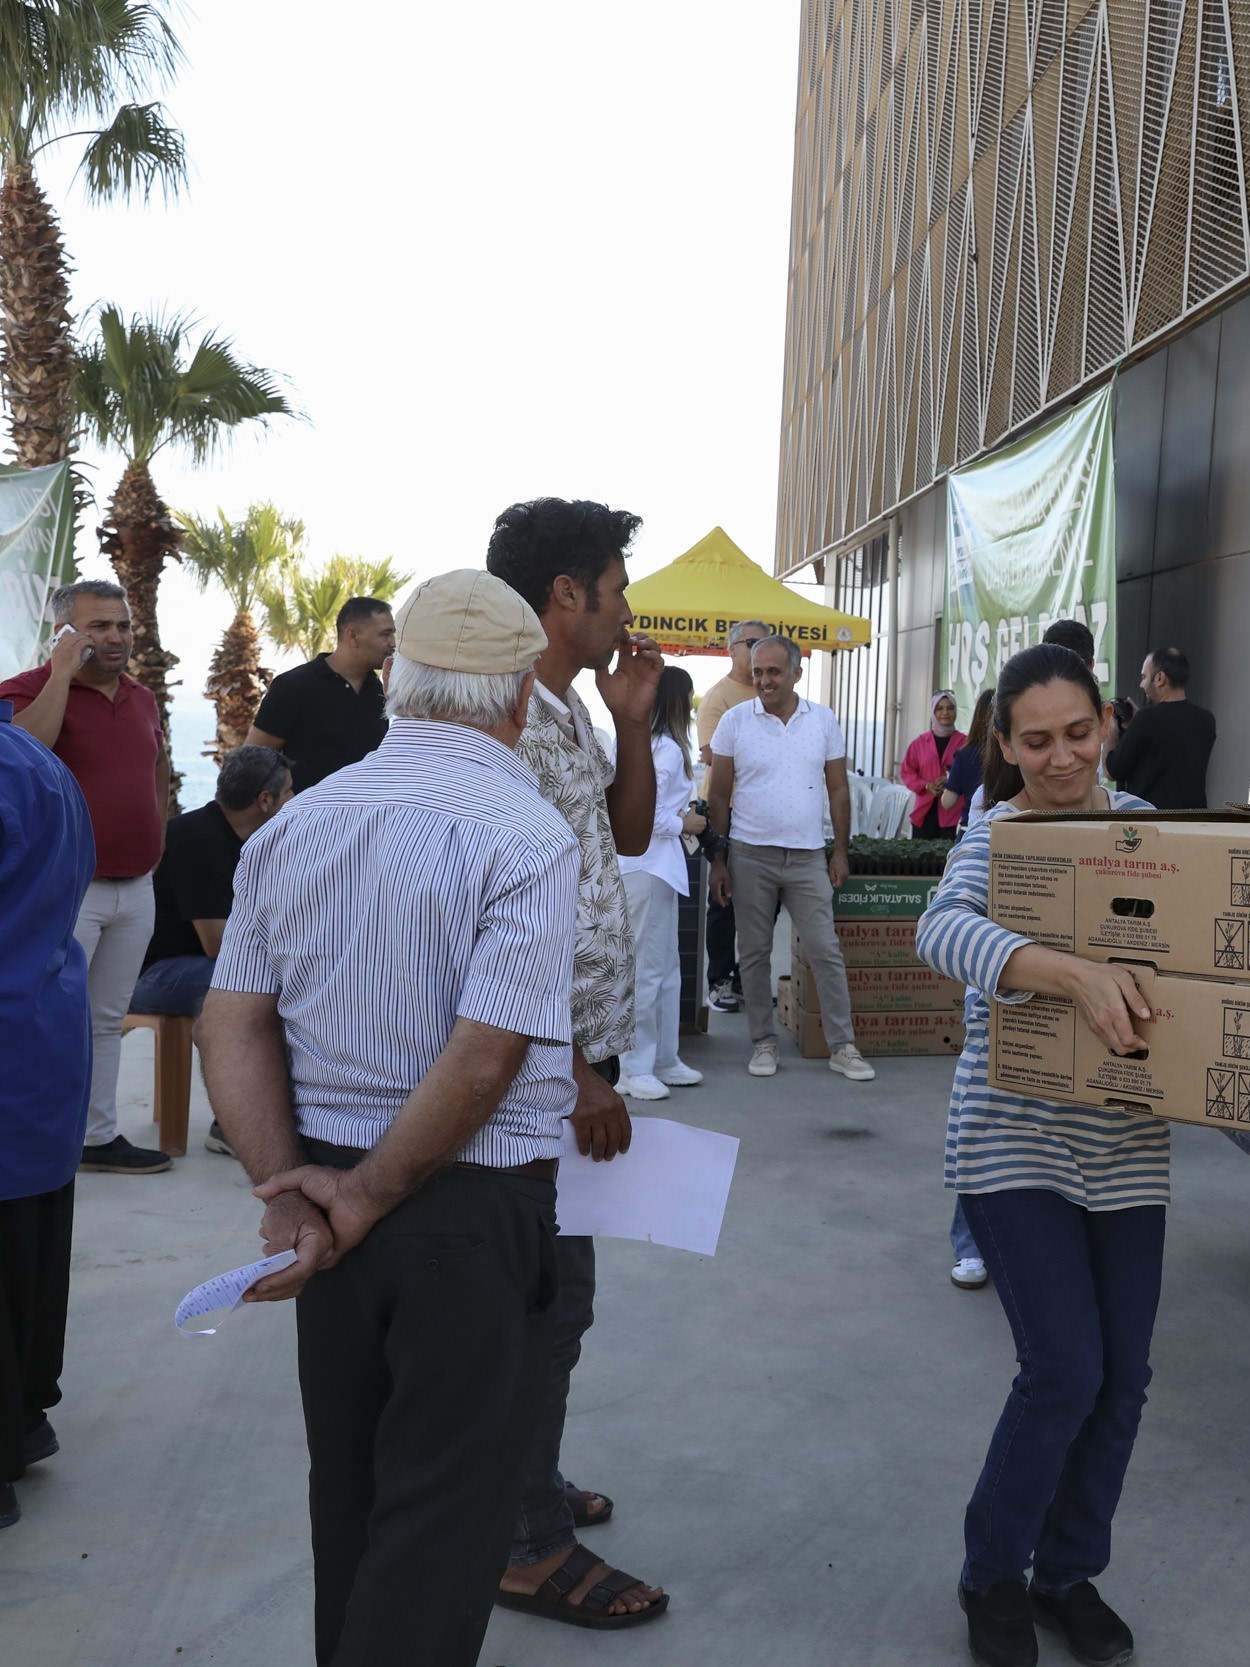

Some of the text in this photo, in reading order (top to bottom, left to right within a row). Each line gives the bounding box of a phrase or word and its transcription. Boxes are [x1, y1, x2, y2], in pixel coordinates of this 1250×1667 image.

[630, 616, 708, 632] YDINCIK
[1078, 857, 1180, 874] antalya tarım a.ş.
[869, 894, 921, 903] SALATALIK
[835, 925, 916, 940] talya tarı
[888, 970, 932, 981] tarım
[1156, 1008, 1174, 1019] a.ş.
[885, 1016, 929, 1026] tarım
